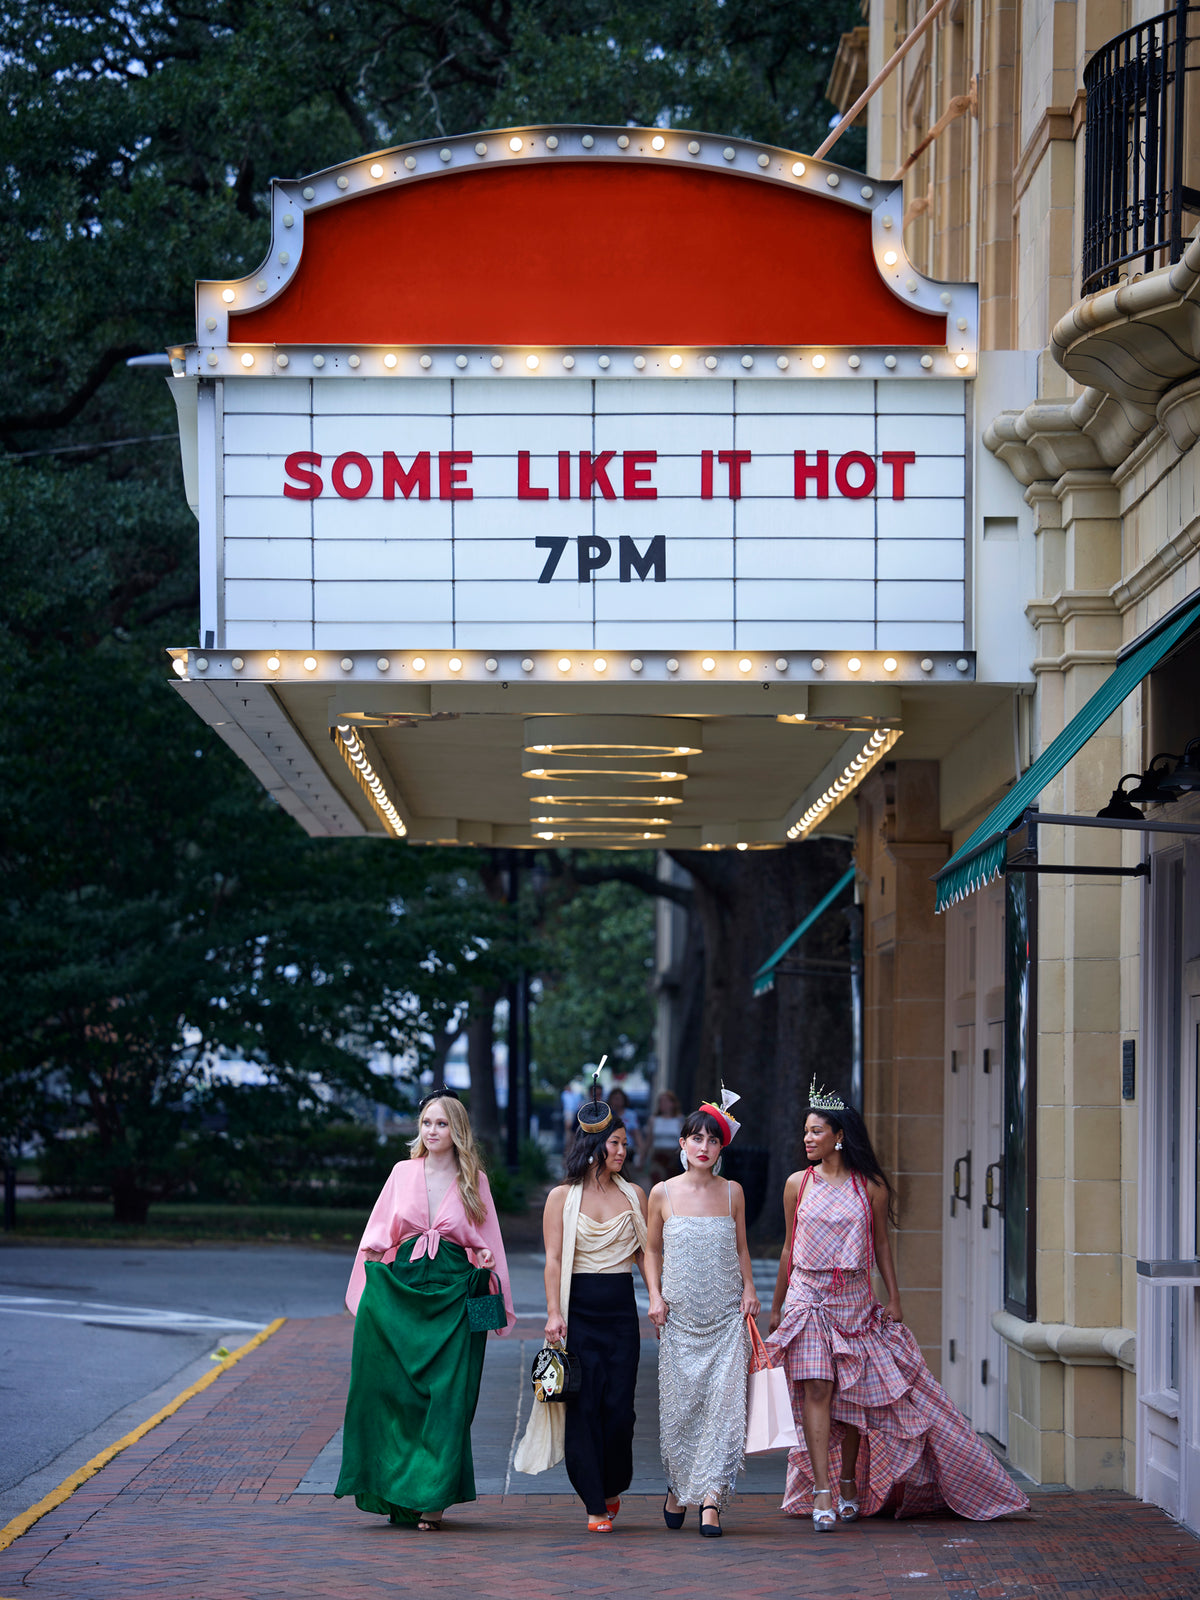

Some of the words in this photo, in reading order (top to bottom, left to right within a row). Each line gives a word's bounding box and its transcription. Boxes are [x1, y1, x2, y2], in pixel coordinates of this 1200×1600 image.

[284, 451, 473, 500] SOME
[518, 451, 657, 500] LIKE
[701, 450, 750, 499] IT
[794, 450, 915, 499] HOT
[535, 535, 667, 583] 7PM
